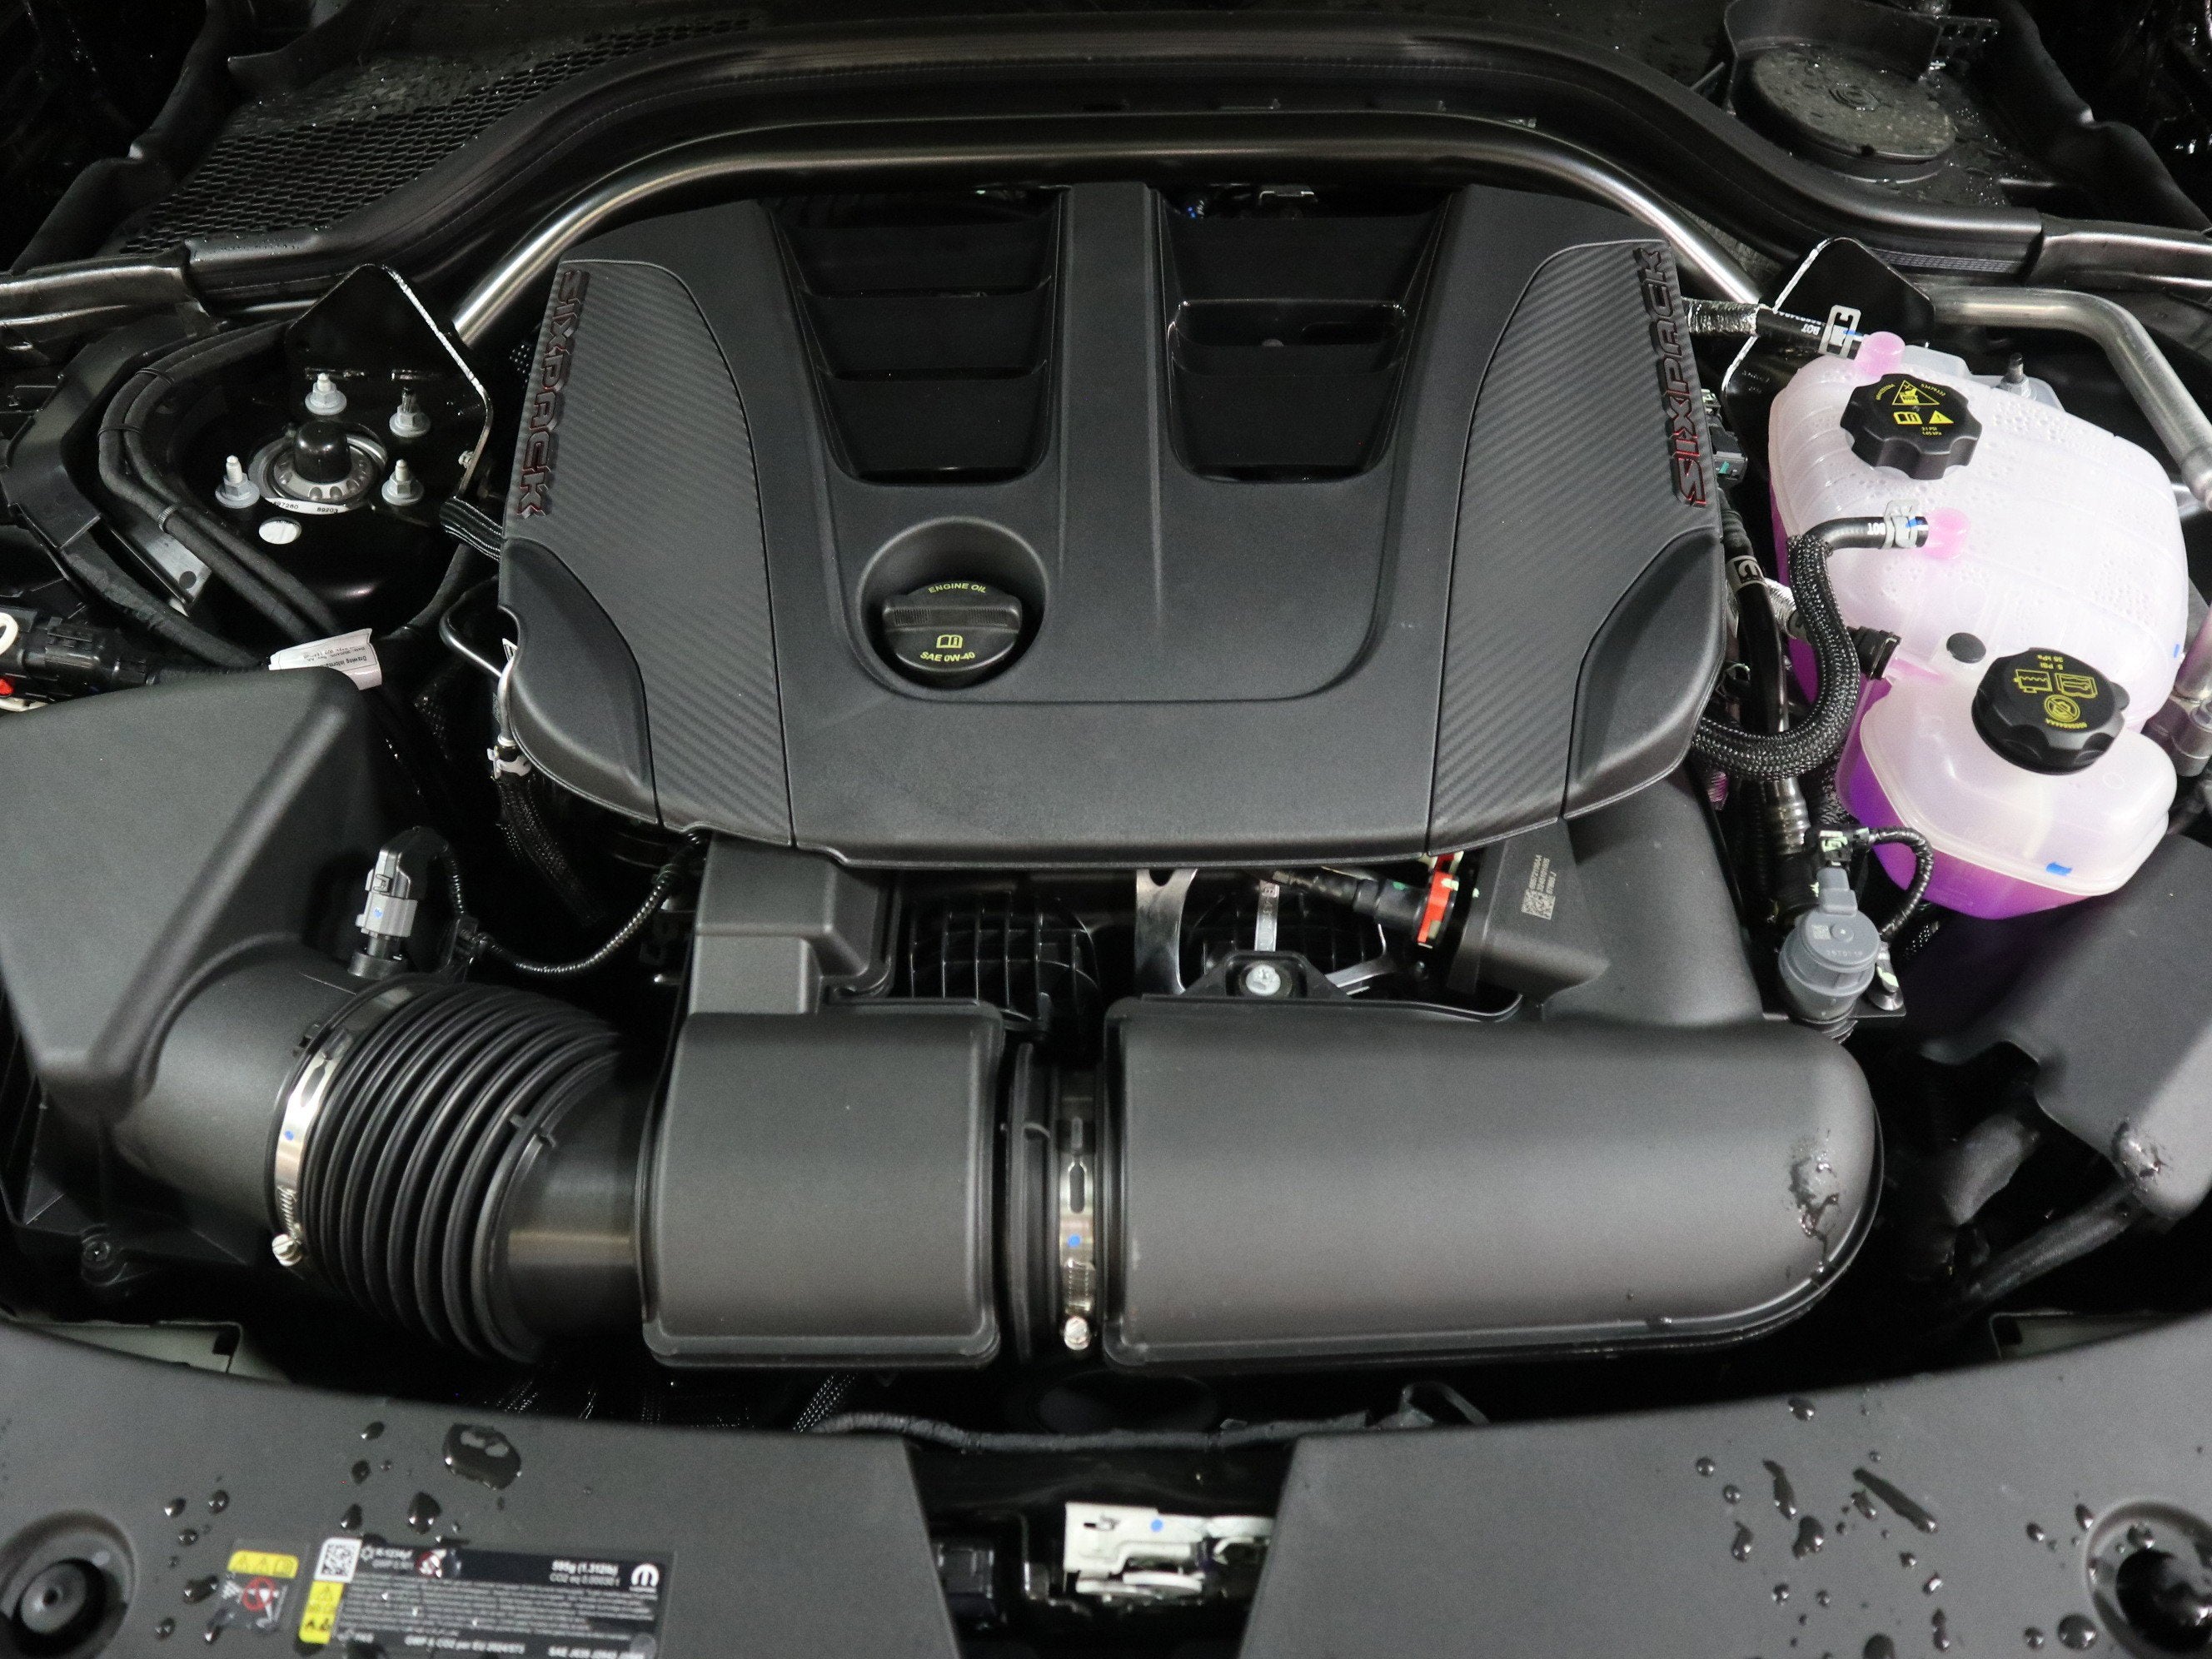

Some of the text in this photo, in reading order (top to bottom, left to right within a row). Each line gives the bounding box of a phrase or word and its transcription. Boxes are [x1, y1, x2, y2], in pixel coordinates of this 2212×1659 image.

[1634, 247, 1707, 508] SIXPACK
[517, 270, 588, 518] SIXPACK
[928, 582, 987, 593] ENGINE OIL
[346, 655, 367, 664] Drawing
[919, 650, 976, 662] SAE 0W-40
